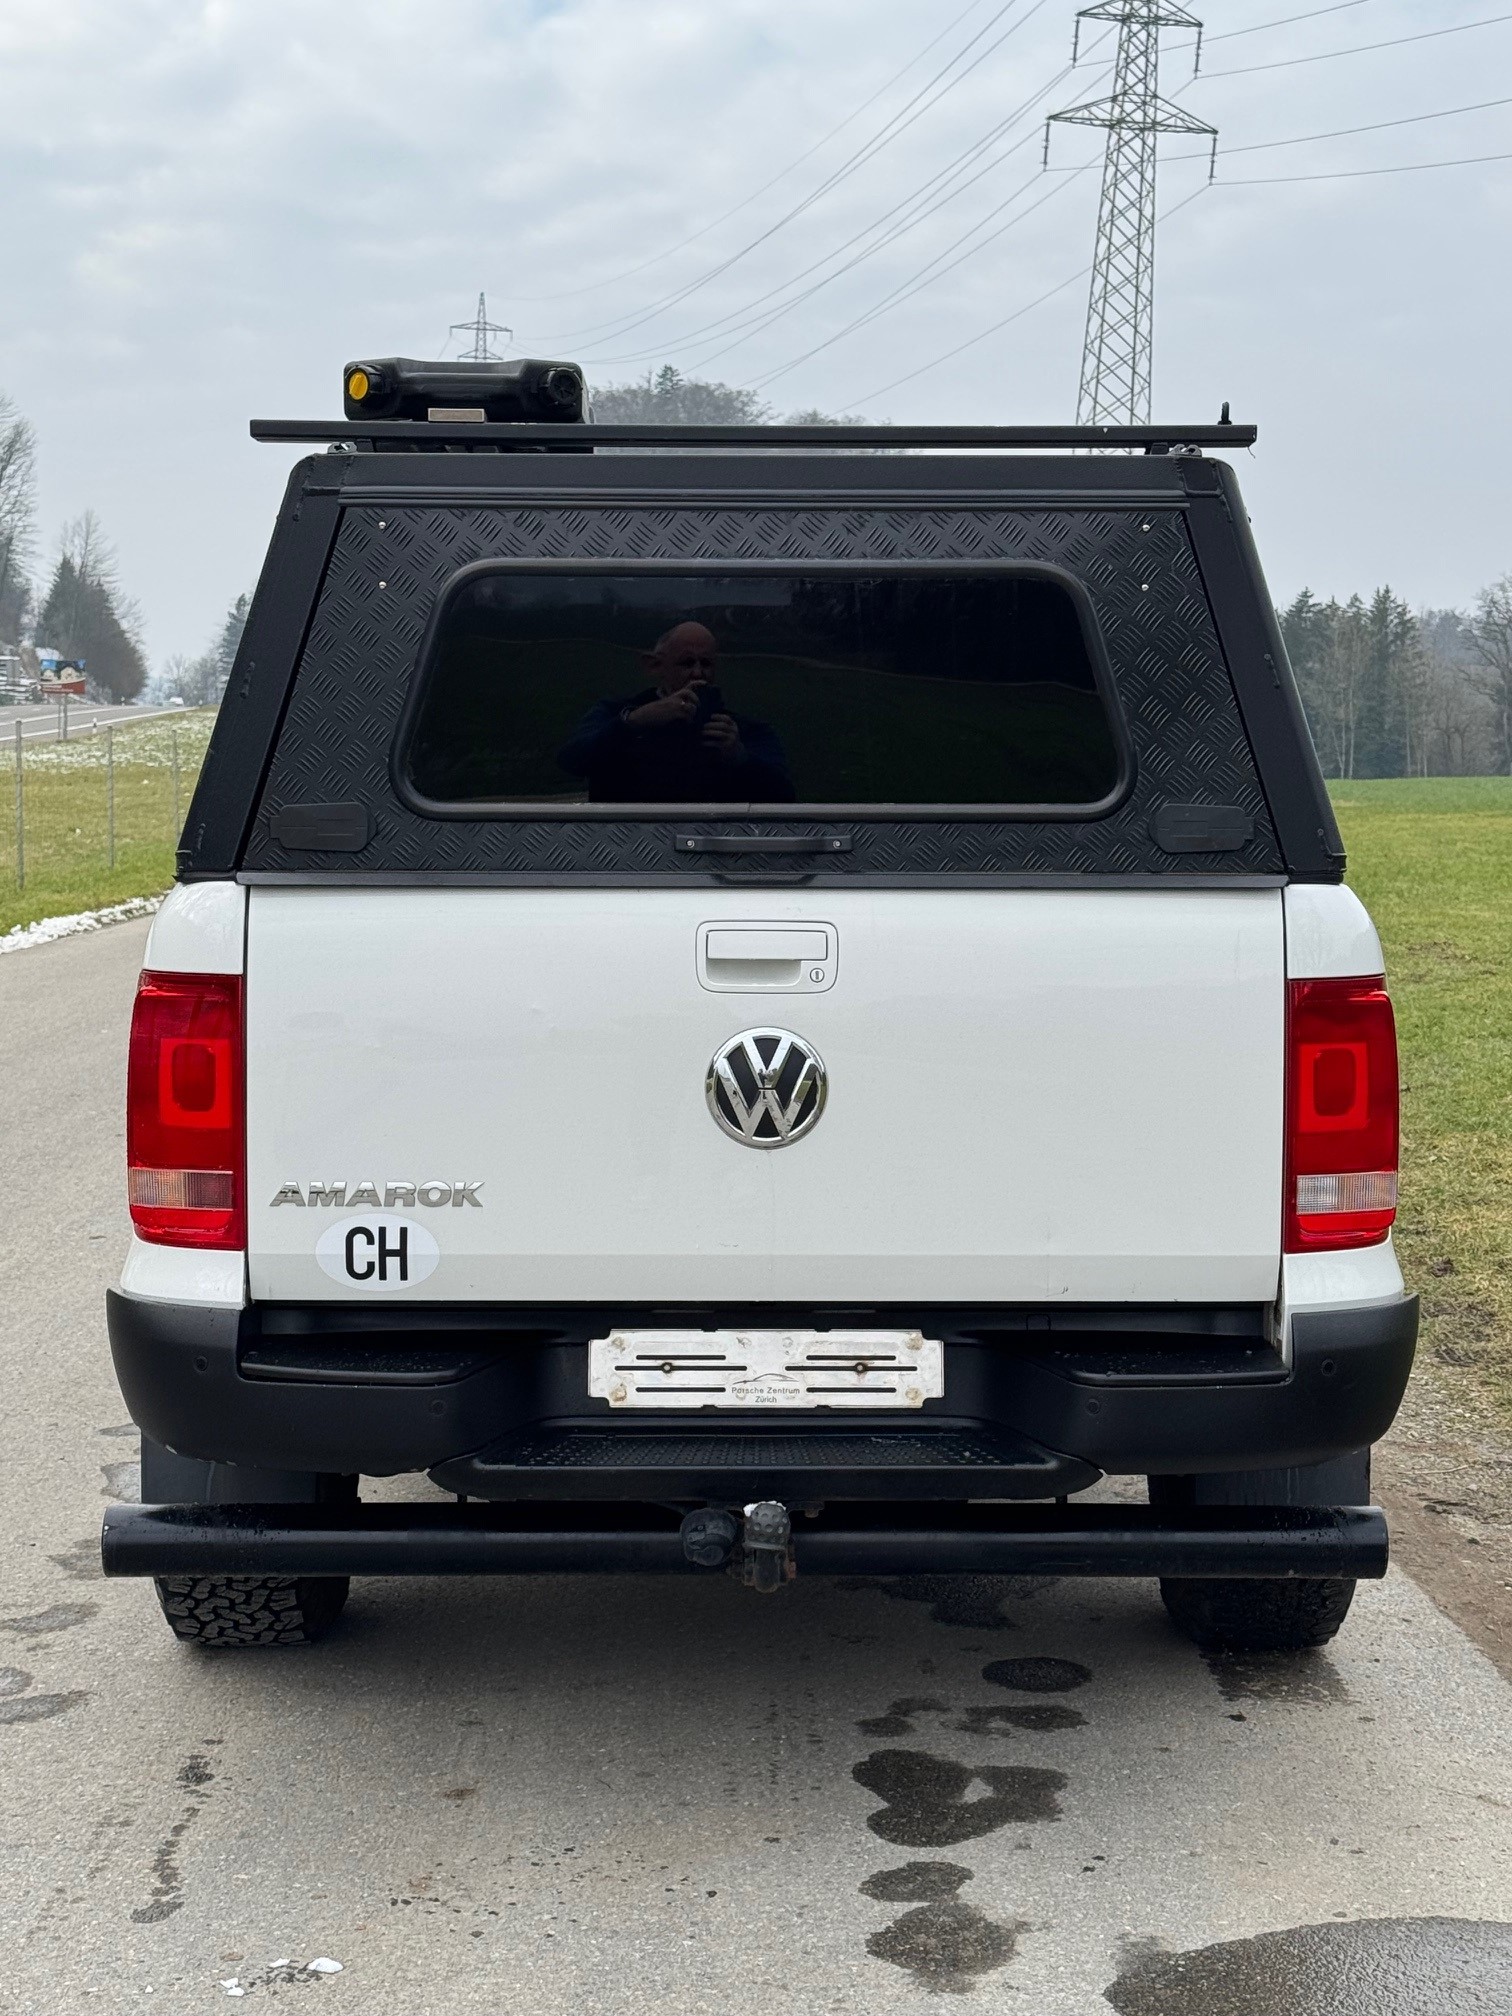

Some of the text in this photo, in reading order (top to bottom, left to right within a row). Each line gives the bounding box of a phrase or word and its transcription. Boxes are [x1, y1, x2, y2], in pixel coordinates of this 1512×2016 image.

[711, 1032, 821, 1143] VW
[269, 1180, 485, 1207] AMAROK
[345, 1226, 408, 1281] CH
[754, 1395, 777, 1403] Zürich
[767, 1386, 800, 1394] Zentrum
